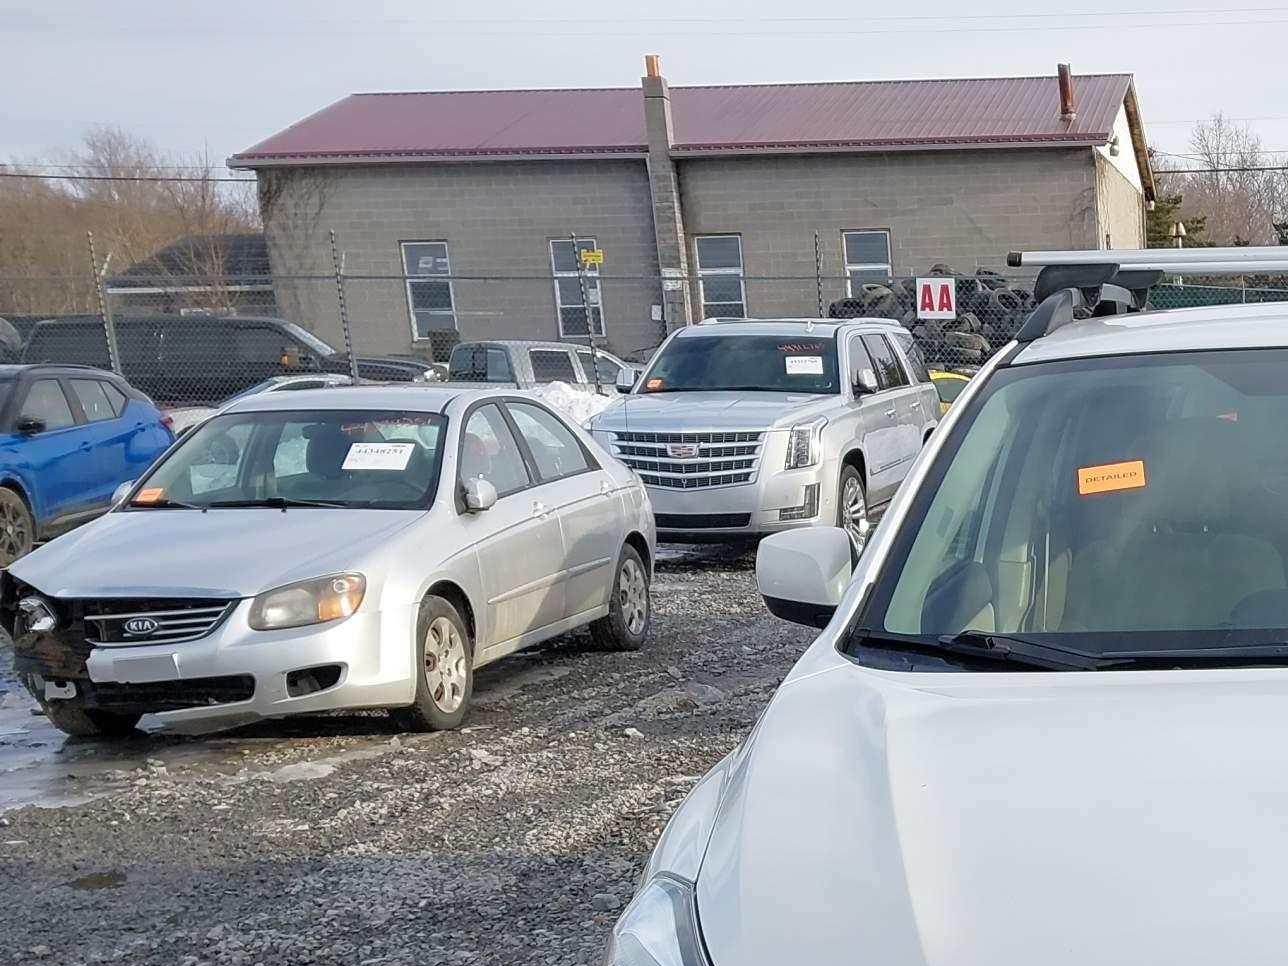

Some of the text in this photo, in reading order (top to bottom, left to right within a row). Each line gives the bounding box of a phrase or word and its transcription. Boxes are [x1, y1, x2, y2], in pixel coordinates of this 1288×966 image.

[920, 284, 953, 311] AA
[1085, 471, 1137, 483] DETAILED
[130, 620, 152, 630] KIA
